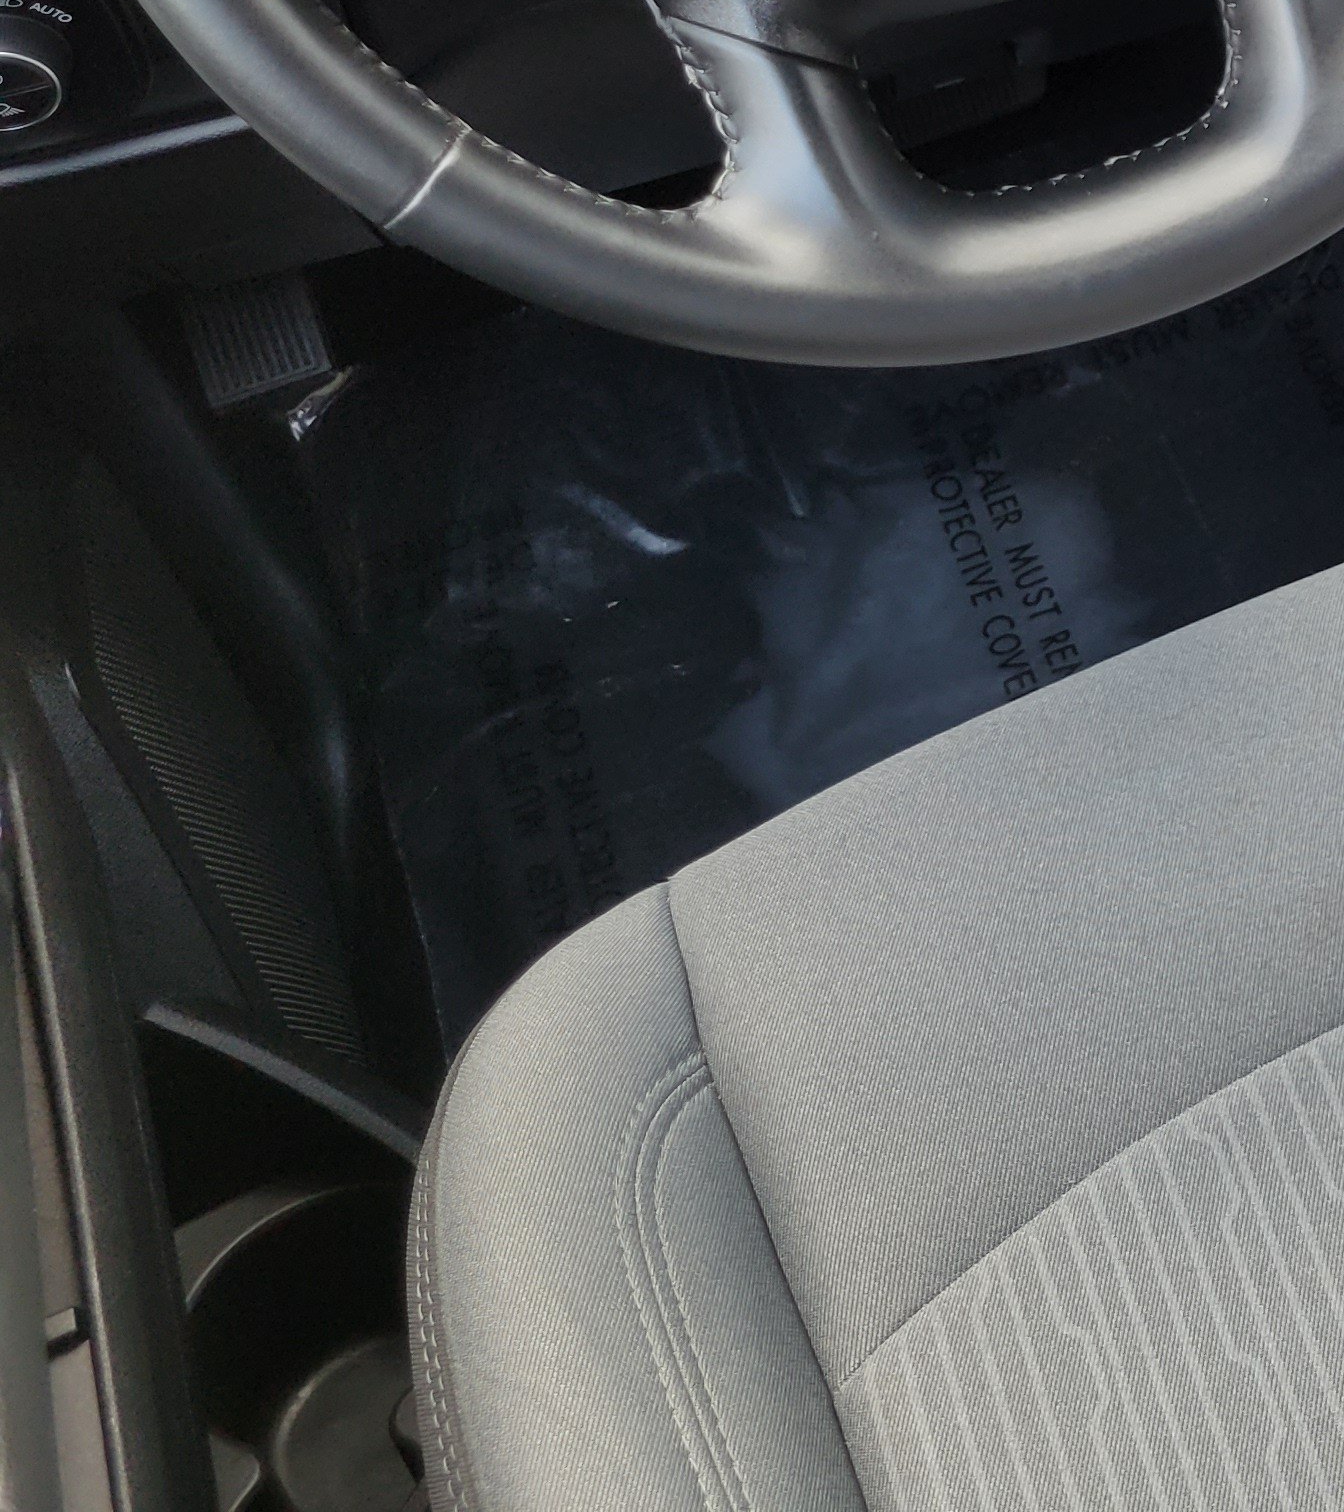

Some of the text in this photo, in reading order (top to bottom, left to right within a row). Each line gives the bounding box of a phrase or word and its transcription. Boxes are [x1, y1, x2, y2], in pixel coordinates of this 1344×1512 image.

[30, 2, 72, 23] AUTO
[960, 422, 1022, 531] DEALER
[1005, 542, 1062, 620] MUST
[980, 614, 1037, 699] COVE
